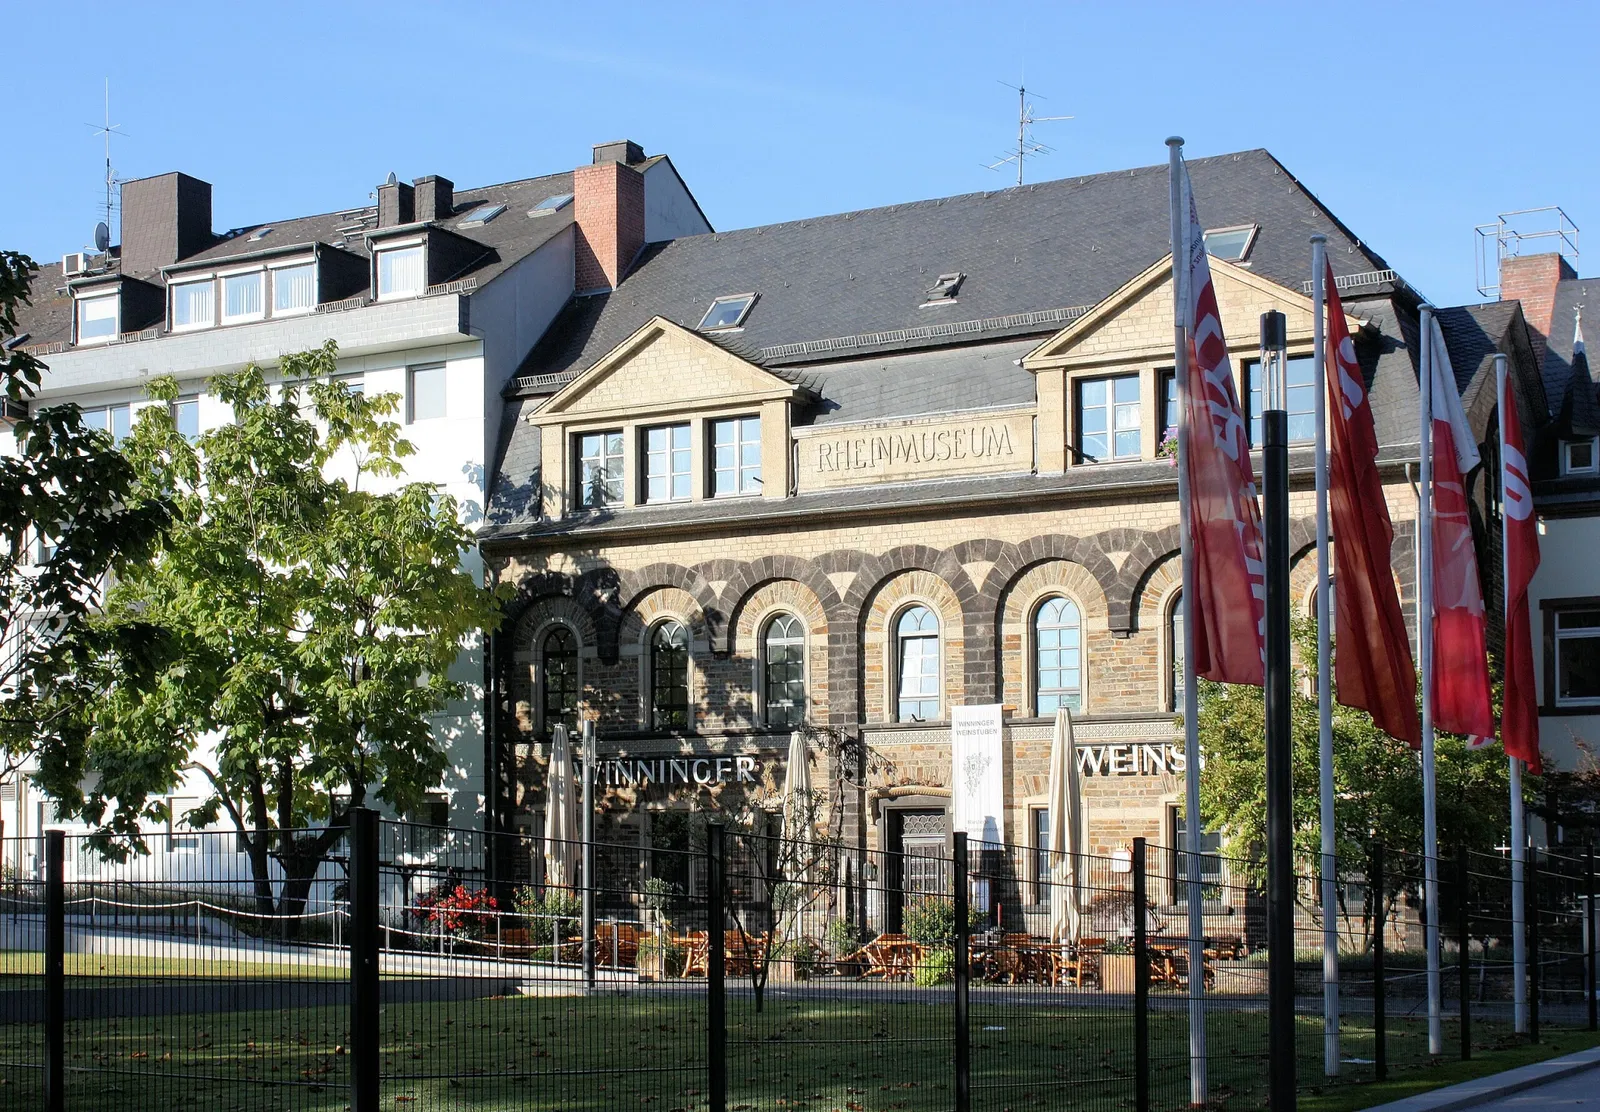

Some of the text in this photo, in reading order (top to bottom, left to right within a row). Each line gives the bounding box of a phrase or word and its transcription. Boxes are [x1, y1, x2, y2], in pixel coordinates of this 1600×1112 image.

[817, 424, 1013, 473] RHEINMUSEUM
[958, 719, 995, 727] WINNINGER
[956, 728, 998, 736] WEINSTUBEN
